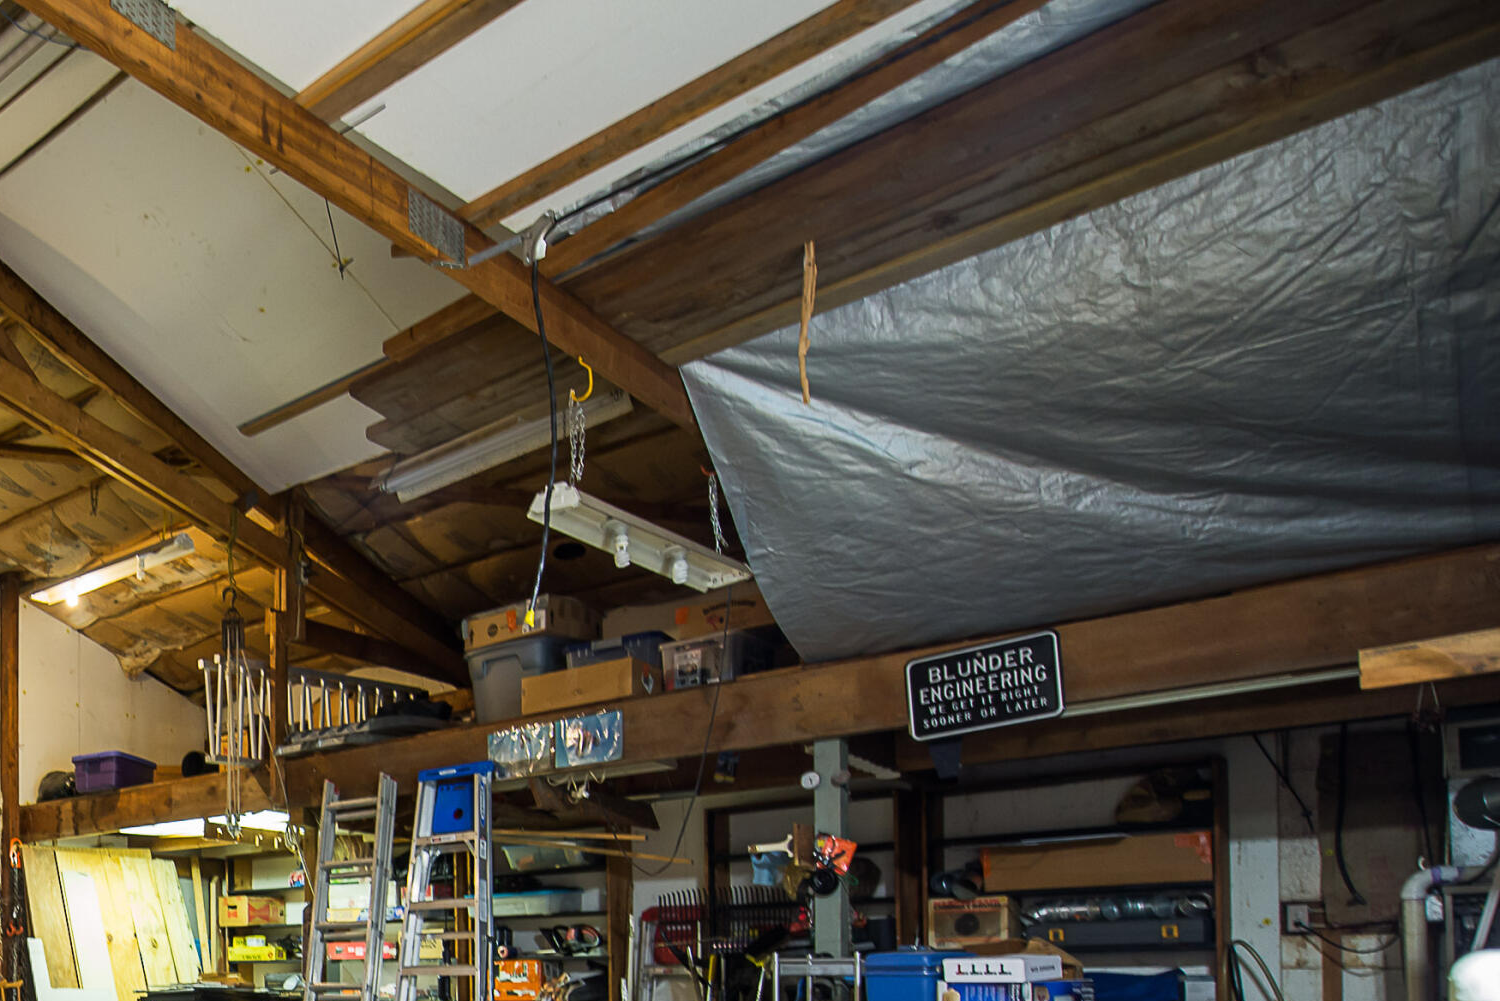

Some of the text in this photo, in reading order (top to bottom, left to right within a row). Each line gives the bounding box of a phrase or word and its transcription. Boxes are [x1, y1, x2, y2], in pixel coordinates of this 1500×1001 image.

[928, 647, 1034, 684] BLUNDER
[919, 663, 1048, 706] ENGINEERING
[928, 685, 1040, 716] WE GET IT RIGHT
[923, 697, 1049, 730] SOONER OR LATER
